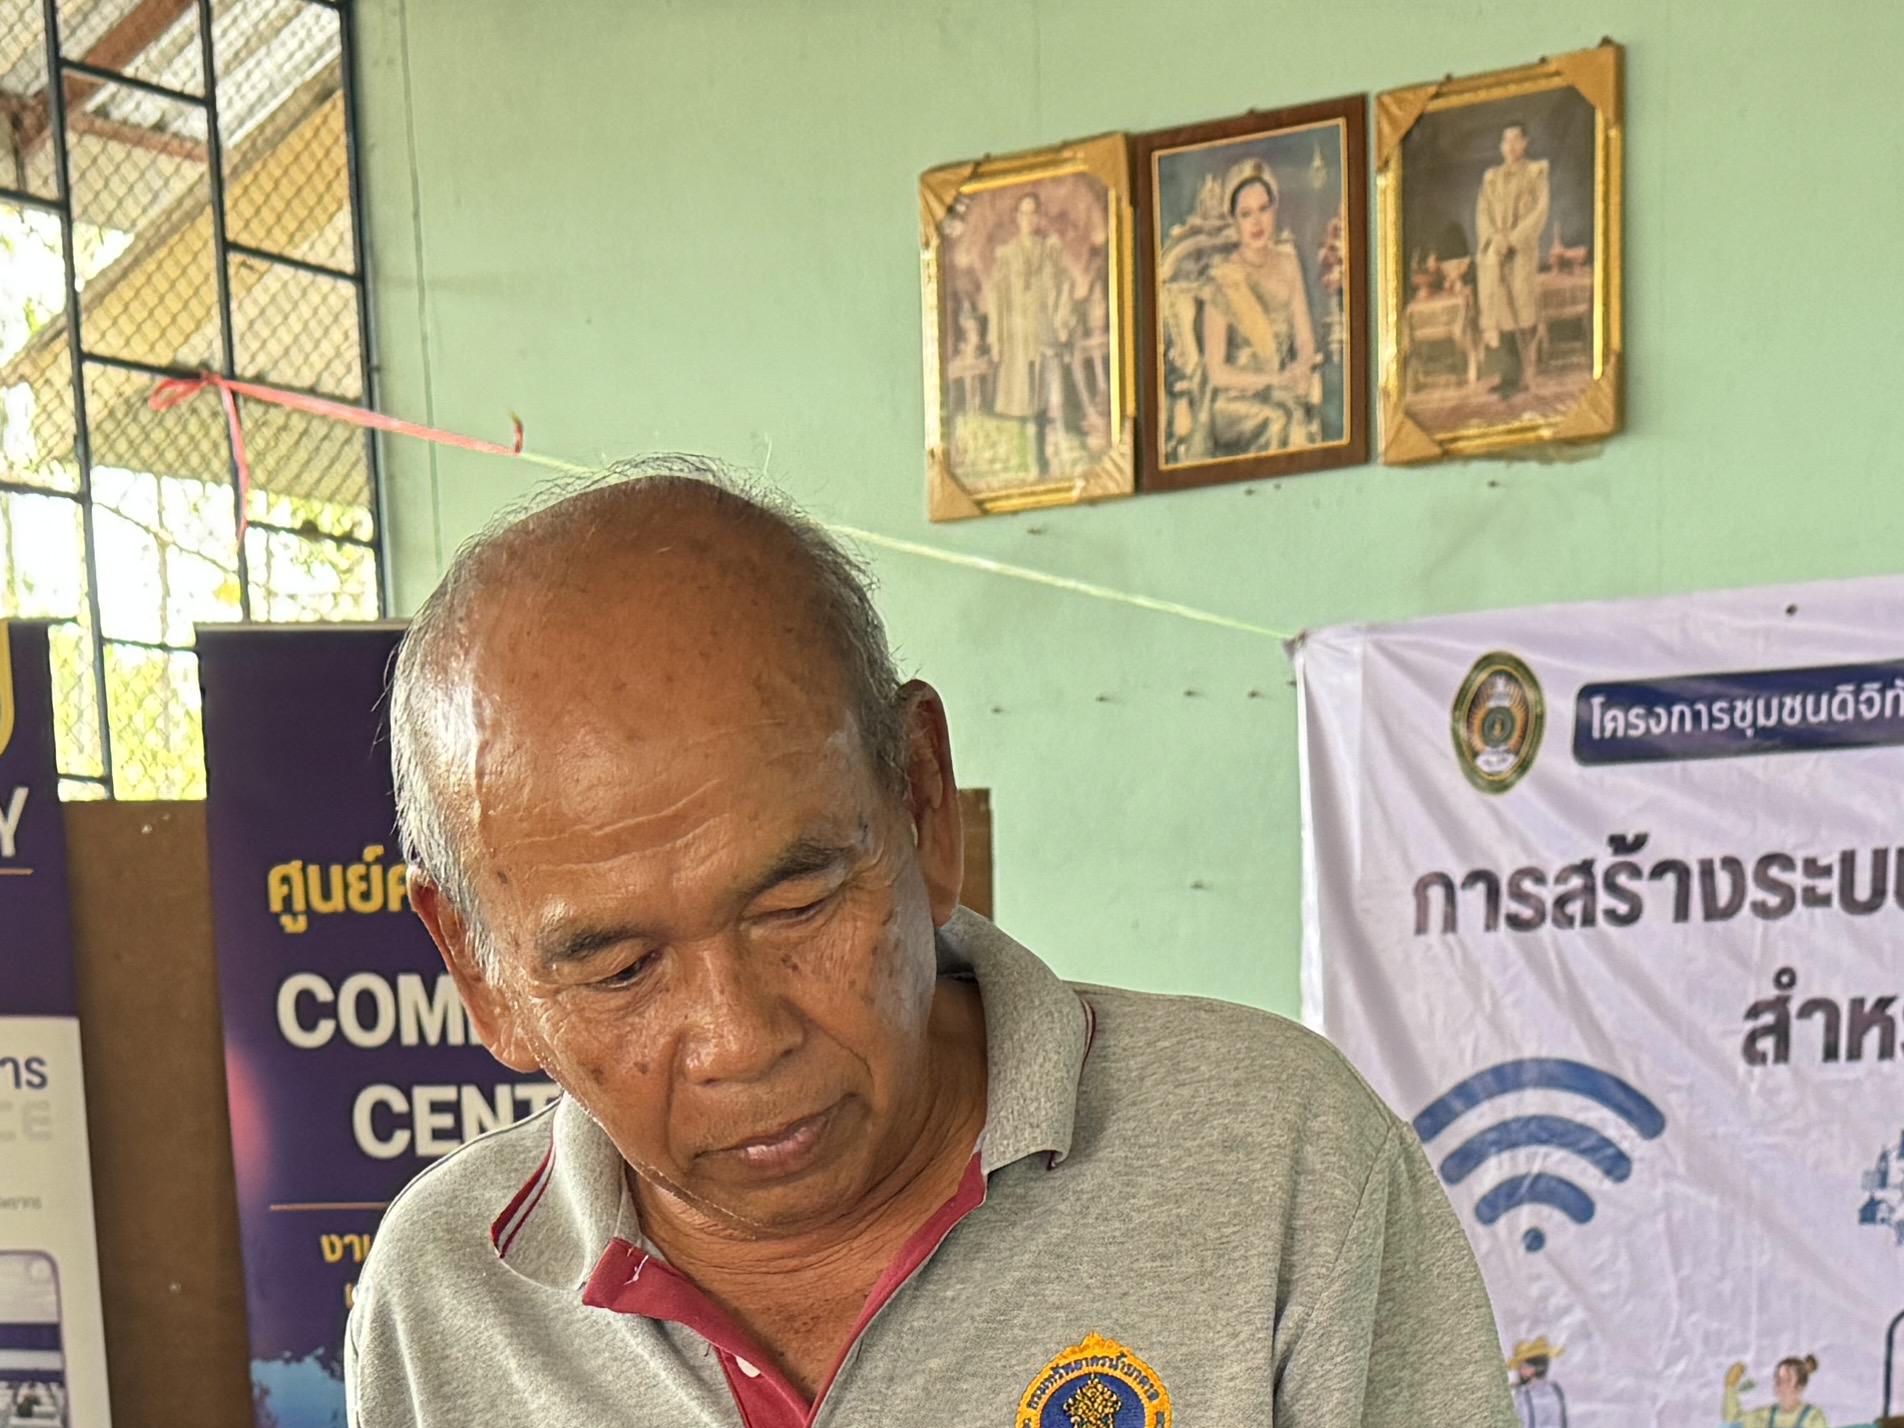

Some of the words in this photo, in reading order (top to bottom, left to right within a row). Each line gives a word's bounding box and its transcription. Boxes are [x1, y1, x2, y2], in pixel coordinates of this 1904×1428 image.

[267, 845, 409, 934] ศูนย์ค
[277, 972, 483, 1048] COM
